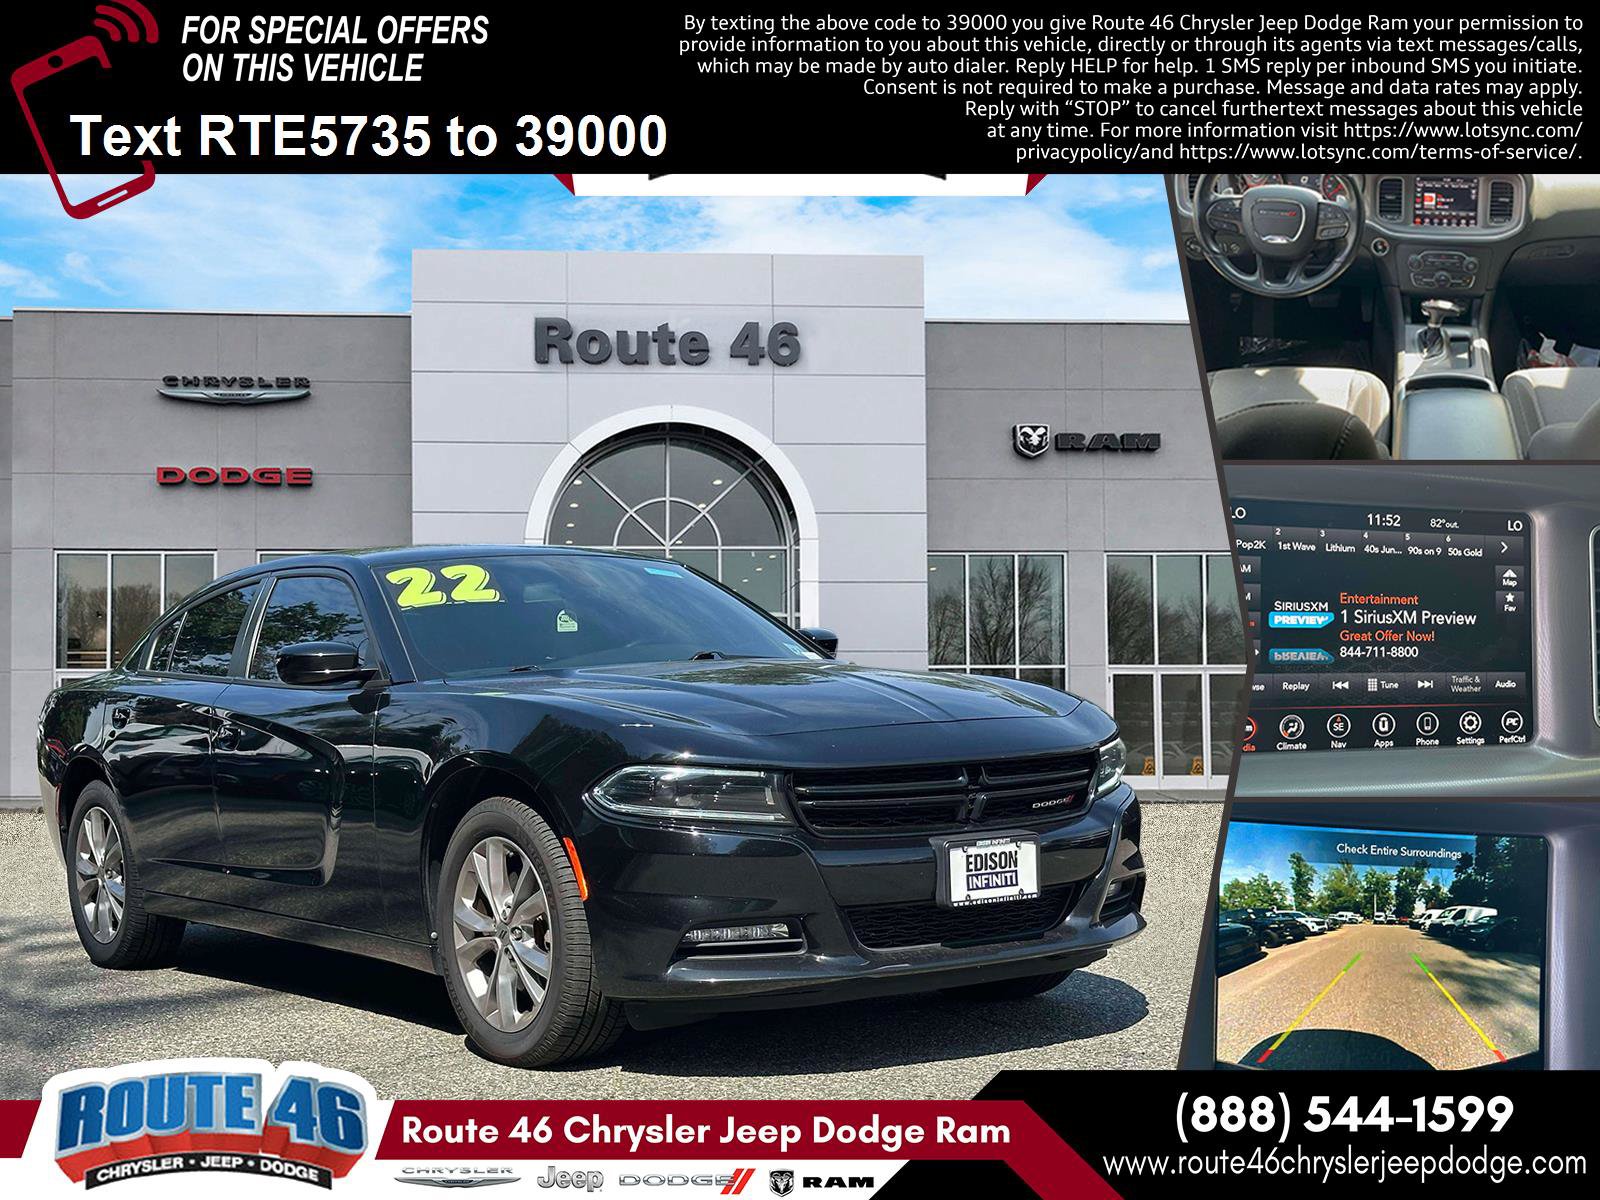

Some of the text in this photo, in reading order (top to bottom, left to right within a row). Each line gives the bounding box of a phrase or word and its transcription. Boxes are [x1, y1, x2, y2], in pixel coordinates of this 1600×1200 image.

[534, 317, 802, 367] Route 46
[162, 375, 311, 388] CHRYSLER
[1055, 432, 1162, 451] RAM
[156, 466, 313, 487] DODGE
[1367, 513, 1401, 528] 11:52
[1508, 520, 1523, 532] LO
[1276, 528, 1281, 536] 2
[1320, 530, 1326, 538] 3
[1363, 531, 1369, 539] 4
[1405, 533, 1411, 541] 5
[1446, 535, 1451, 543] 6
[1236, 539, 1266, 550] Pop2K
[1278, 541, 1316, 552] 1st Wave
[1326, 543, 1356, 553] Lithium
[1363, 545, 1380, 554] 40s
[1408, 546, 1442, 556] 90s on 9
[1448, 547, 1483, 557] 50s Gold
[385, 564, 501, 608] 22
[1502, 579, 1518, 588] Map
[1340, 592, 1418, 606] Entertainment
[1274, 600, 1328, 612] SIRIUSXM
[1504, 604, 1516, 612] Fav
[1341, 610, 1476, 626] 1 SiriusXM Preview
[1340, 630, 1435, 642] Great Offer Now!
[1340, 646, 1418, 658] 844-711-8800
[1381, 680, 1400, 689] Tune
[1451, 675, 1474, 684] Traffic
[1494, 680, 1516, 688] Audio
[1282, 682, 1310, 692] Replay
[1451, 684, 1482, 692] Weather
[1276, 742, 1307, 750] Climate
[1330, 740, 1347, 749] Nav
[1374, 740, 1394, 748] Apps
[1416, 738, 1440, 746] Phone
[1456, 736, 1485, 746] Settings
[1336, 842, 1462, 860] Check Entire Surroundings
[966, 850, 1018, 872] EDISON
[968, 872, 1017, 889] INFINITI
